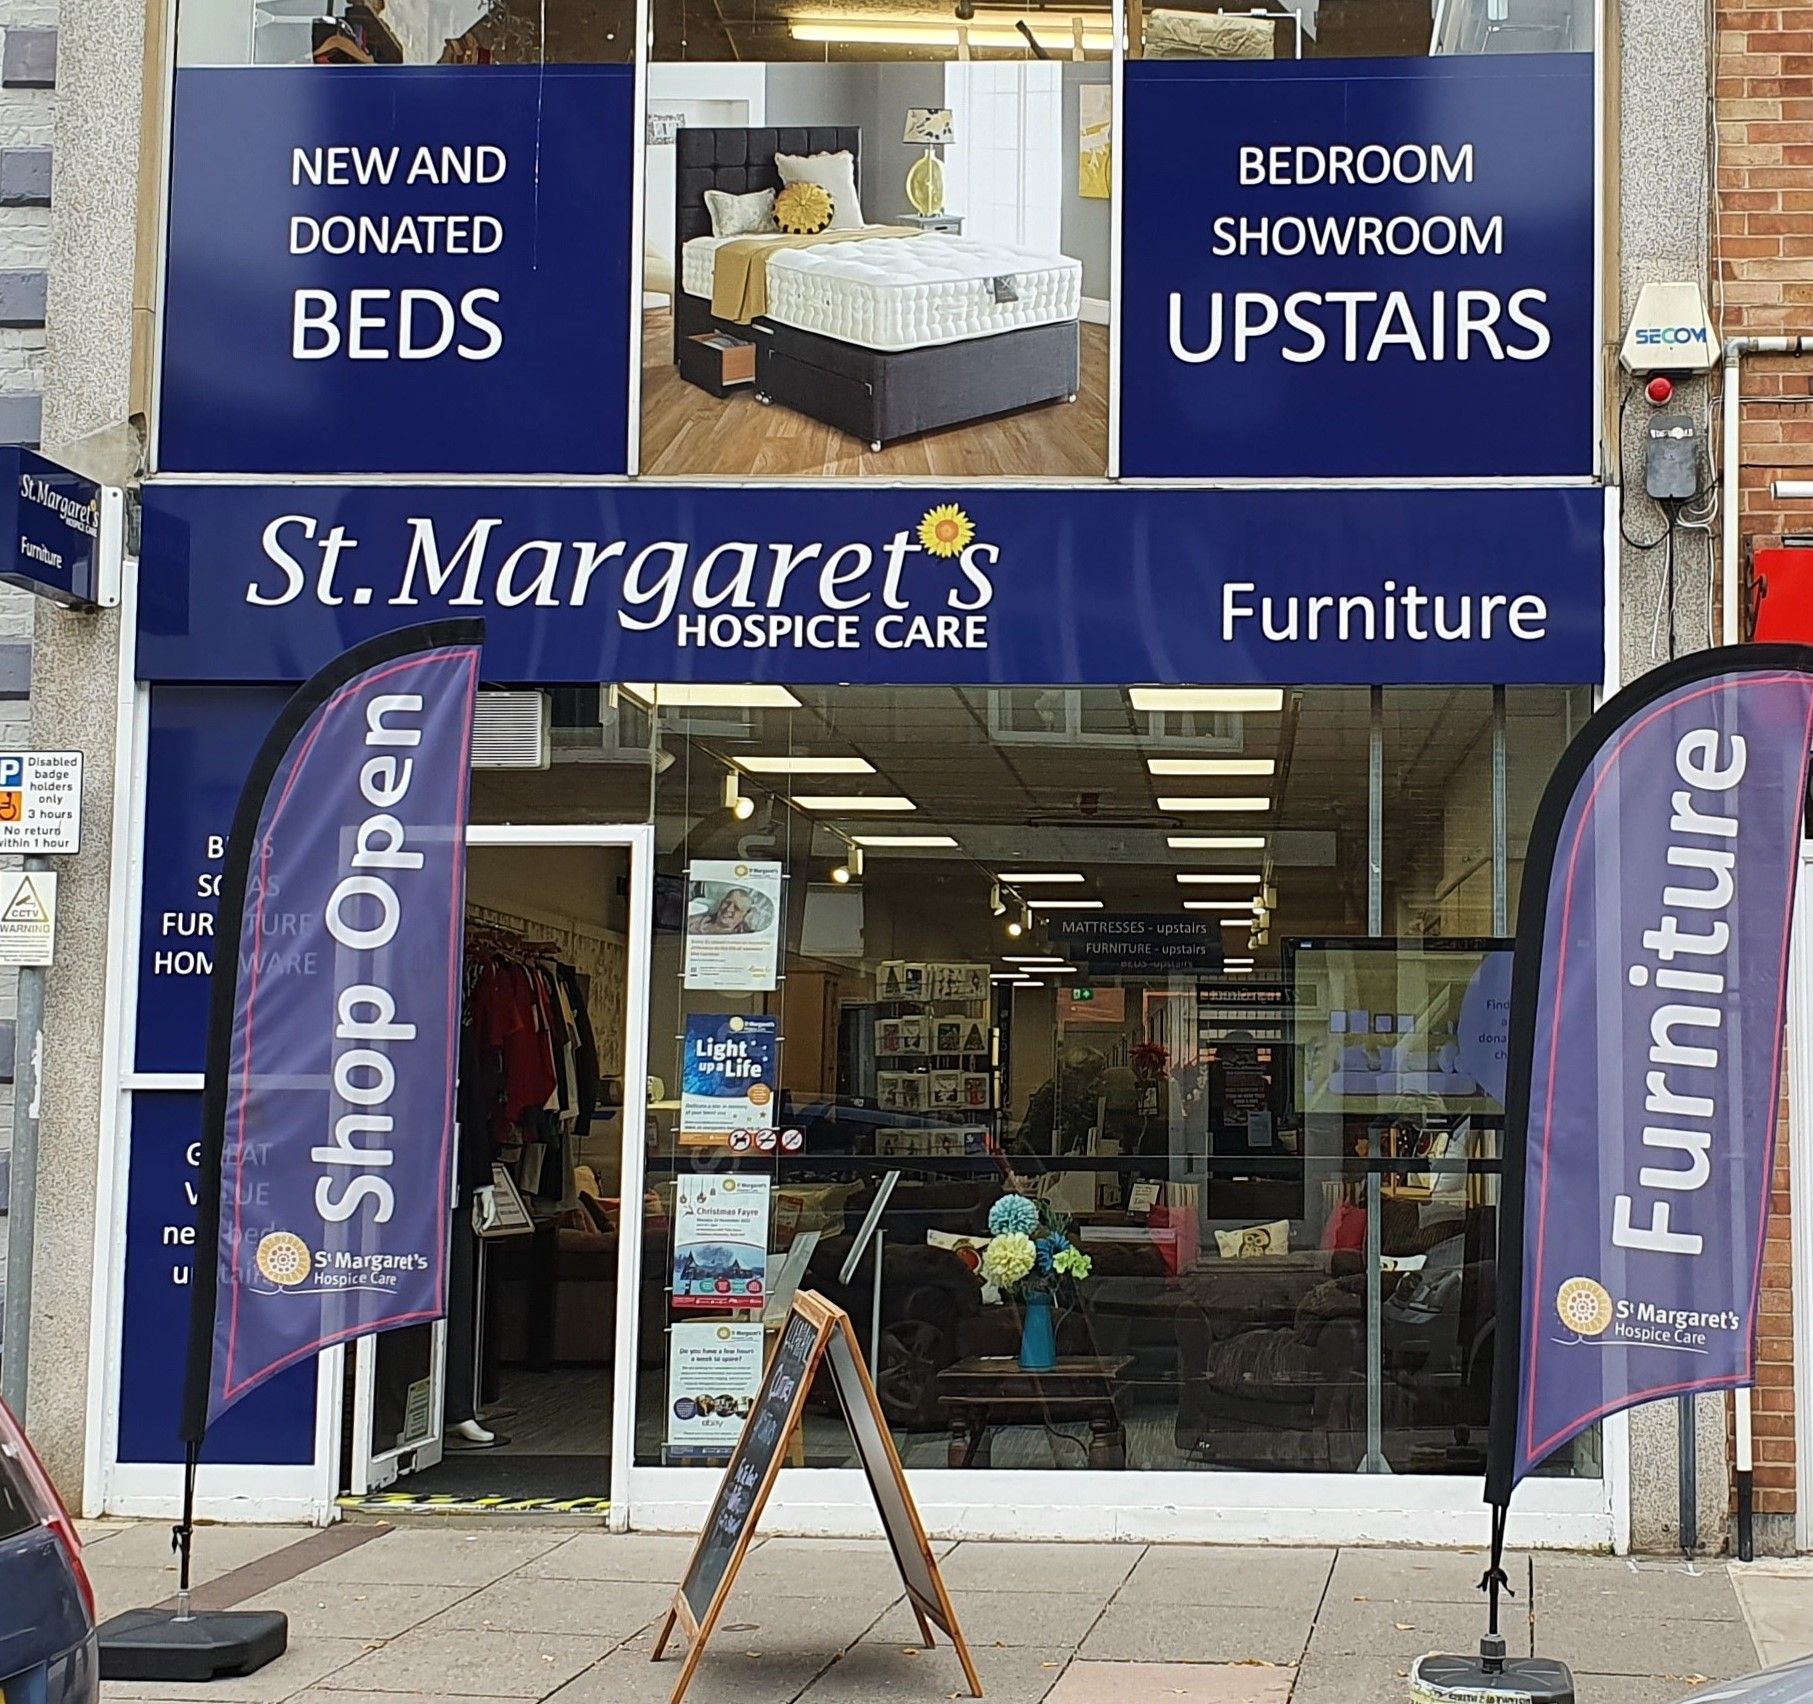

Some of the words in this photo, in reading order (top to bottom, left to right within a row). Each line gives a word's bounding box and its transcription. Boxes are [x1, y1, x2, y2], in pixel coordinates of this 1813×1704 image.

[291, 145, 400, 186] NEW
[406, 145, 507, 185] AND
[1239, 143, 1475, 185] BEDROOM
[289, 215, 504, 255] DONATED
[1211, 214, 1504, 256] SHOWROOM
[292, 287, 503, 361] BEDS
[1168, 288, 1552, 364] UPSTAIRS
[1635, 327, 1708, 345] SECOM
[21, 535, 63, 569] Furniture
[245, 514, 374, 607] St.
[1222, 580, 1548, 641] Furniture
[677, 614, 861, 649] HOSPICE
[874, 614, 989, 649] CARE
[2, 759, 20, 785] P
[28, 757, 78, 767] Disabled
[34, 769, 70, 780] badge
[29, 782, 73, 792] holders
[38, 794, 64, 806] only
[28, 809, 35, 819] 3
[39, 809, 73, 819] hours
[325, 693, 424, 950] Open
[4, 826, 21, 836] No
[24, 826, 62, 836] return
[34, 839, 40, 848] 1
[42, 838, 70, 848] hour
[197, 873, 281, 898] SAS
[11, 909, 39, 918] CCTV
[161, 912, 313, 937] FURTURE
[0, 924, 51, 934] WARNING
[1062, 921, 1145, 934] MATTRESSES
[1156, 921, 1208, 936] upstairs
[1086, 942, 1152, 955] FURNITURE
[1162, 942, 1207, 957] upstairs
[153, 950, 318, 975] HOMWARE
[1612, 728, 1748, 1255] Furniture
[696, 1037, 748, 1061] Light
[698, 1062, 715, 1074] up
[716, 1062, 723, 1072] a
[725, 1058, 762, 1078] Life
[310, 983, 418, 1224] Shop
[185, 1142, 273, 1167] GEAT
[696, 1207, 736, 1215] Christmas
[737, 1207, 759, 1218] Fayre
[314, 1250, 333, 1268] St
[334, 1251, 429, 1271] Margaret's
[314, 1271, 367, 1289] Hospice
[370, 1271, 397, 1286] Care
[1616, 1300, 1635, 1319] St
[1636, 1302, 1740, 1331] Margaret's
[1614, 1322, 1671, 1343] Hospice
[1674, 1329, 1707, 1346] Care
